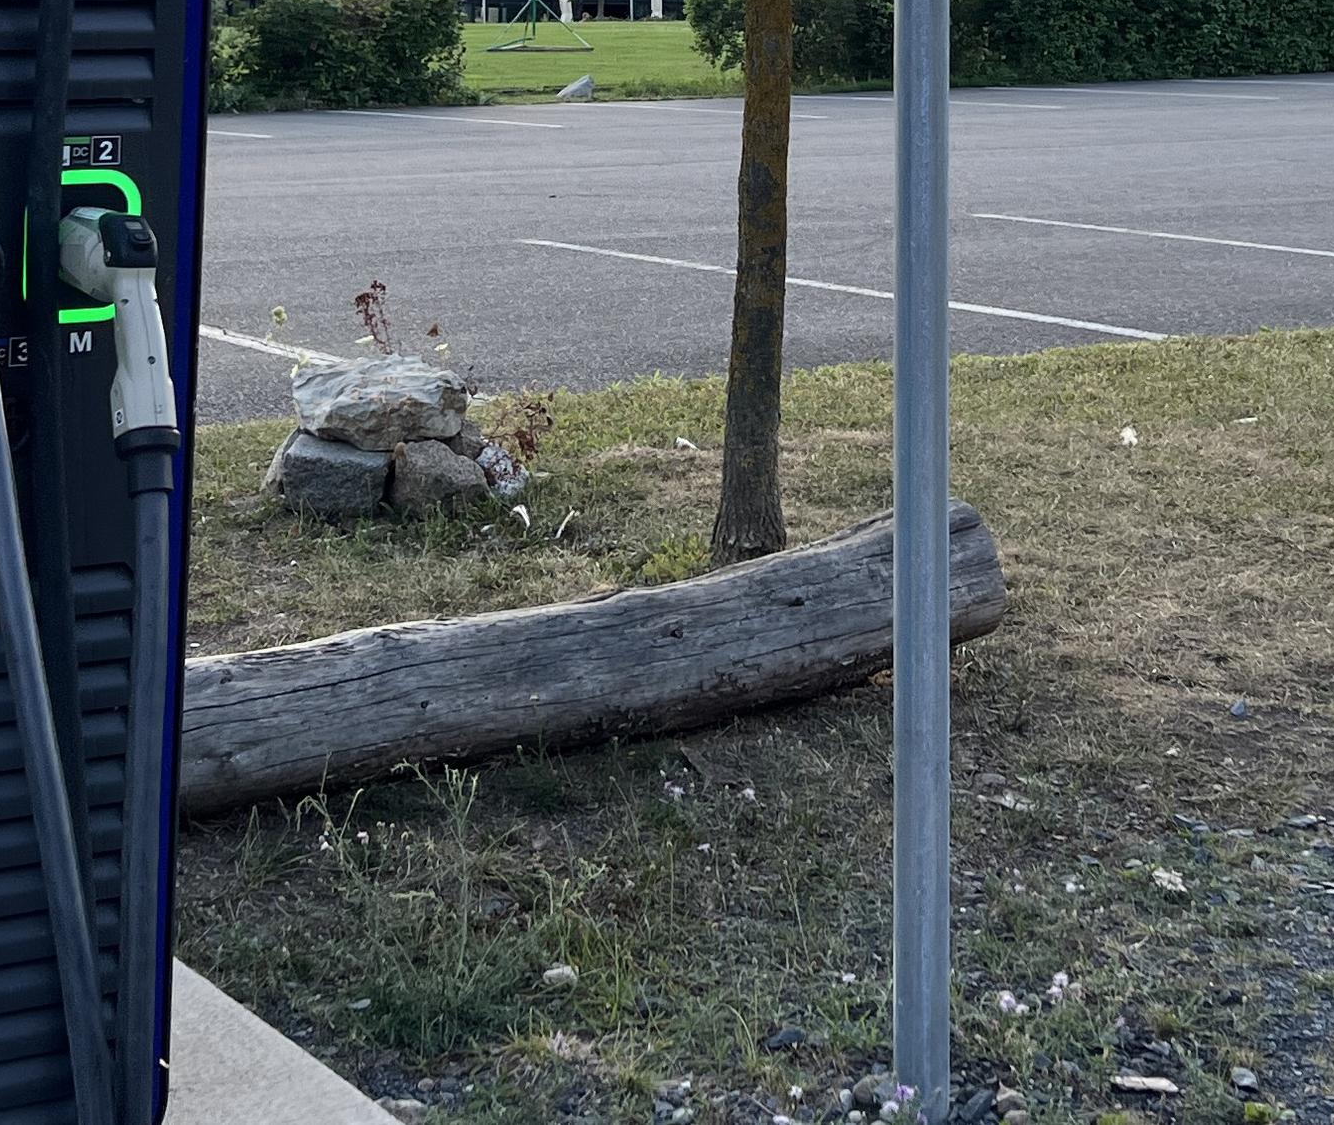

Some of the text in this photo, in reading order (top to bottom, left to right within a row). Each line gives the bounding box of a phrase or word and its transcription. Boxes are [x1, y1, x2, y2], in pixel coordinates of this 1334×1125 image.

[72, 146, 89, 157] DC
[99, 140, 113, 161] 2
[69, 330, 92, 353] M
